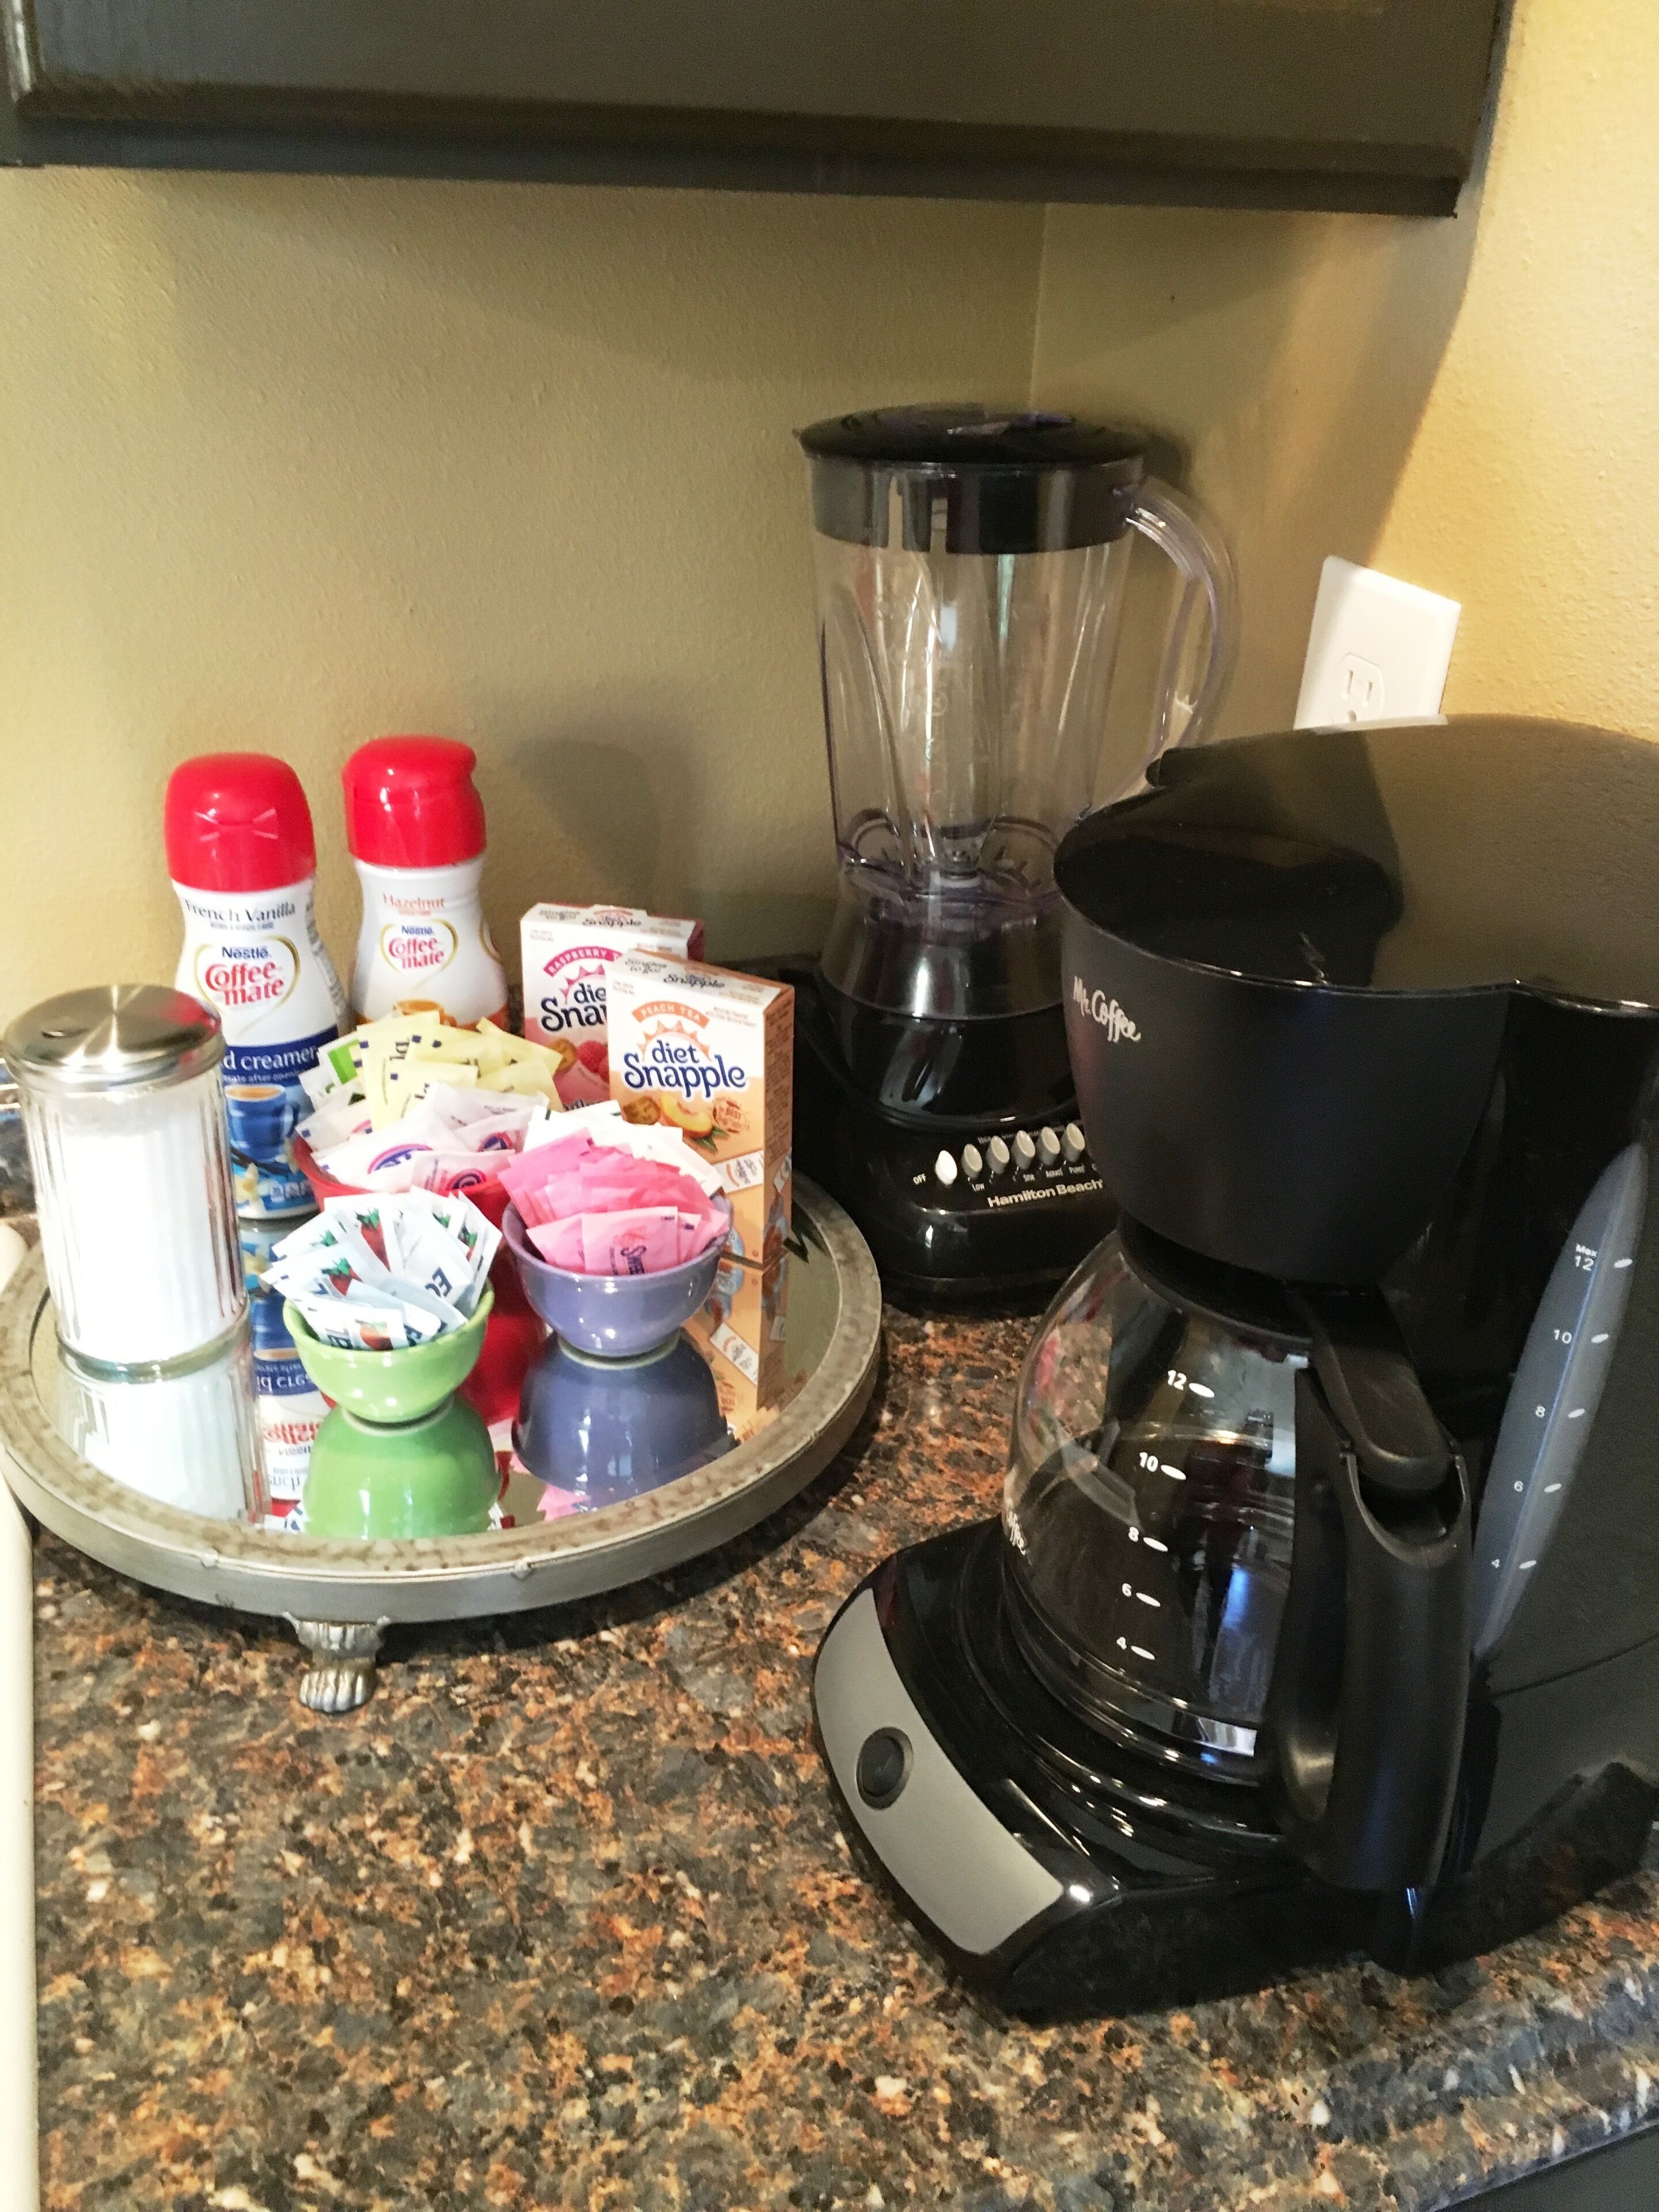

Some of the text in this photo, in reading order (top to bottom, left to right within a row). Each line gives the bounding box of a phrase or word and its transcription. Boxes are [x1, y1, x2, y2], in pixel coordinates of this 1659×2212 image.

[185, 899, 296, 922] French Vanilla
[382, 893, 445, 908] Hazelnut
[389, 937, 438, 958] Coffee
[401, 950, 444, 968] mate
[548, 948, 608, 974] RASPBERRY
[205, 961, 276, 991] Coffee
[224, 979, 284, 1005] mate
[573, 983, 607, 1005] die
[641, 1002, 675, 1017] PEACH
[681, 1005, 700, 1022] TEA
[1092, 990, 1142, 1043] Coffee
[241, 1047, 316, 1070] creamer
[652, 1039, 699, 1063] diet
[623, 1052, 747, 1098] Snapple
[914, 1173, 926, 1185] OFF
[987, 1179, 1103, 1208] Hamilton Beach
[1574, 1255, 1594, 1271] 12
[1553, 1329, 1572, 1344] 10
[1168, 1369, 1187, 1390] 12
[1535, 1405, 1546, 1418] 8
[1139, 1452, 1158, 1472] 10
[1513, 1480, 1524, 1493] 6
[1128, 1526, 1139, 1542] 8
[1491, 1559, 1500, 1568] 4
[1122, 1582, 1132, 1597] 6
[1116, 1636, 1127, 1649] 4
